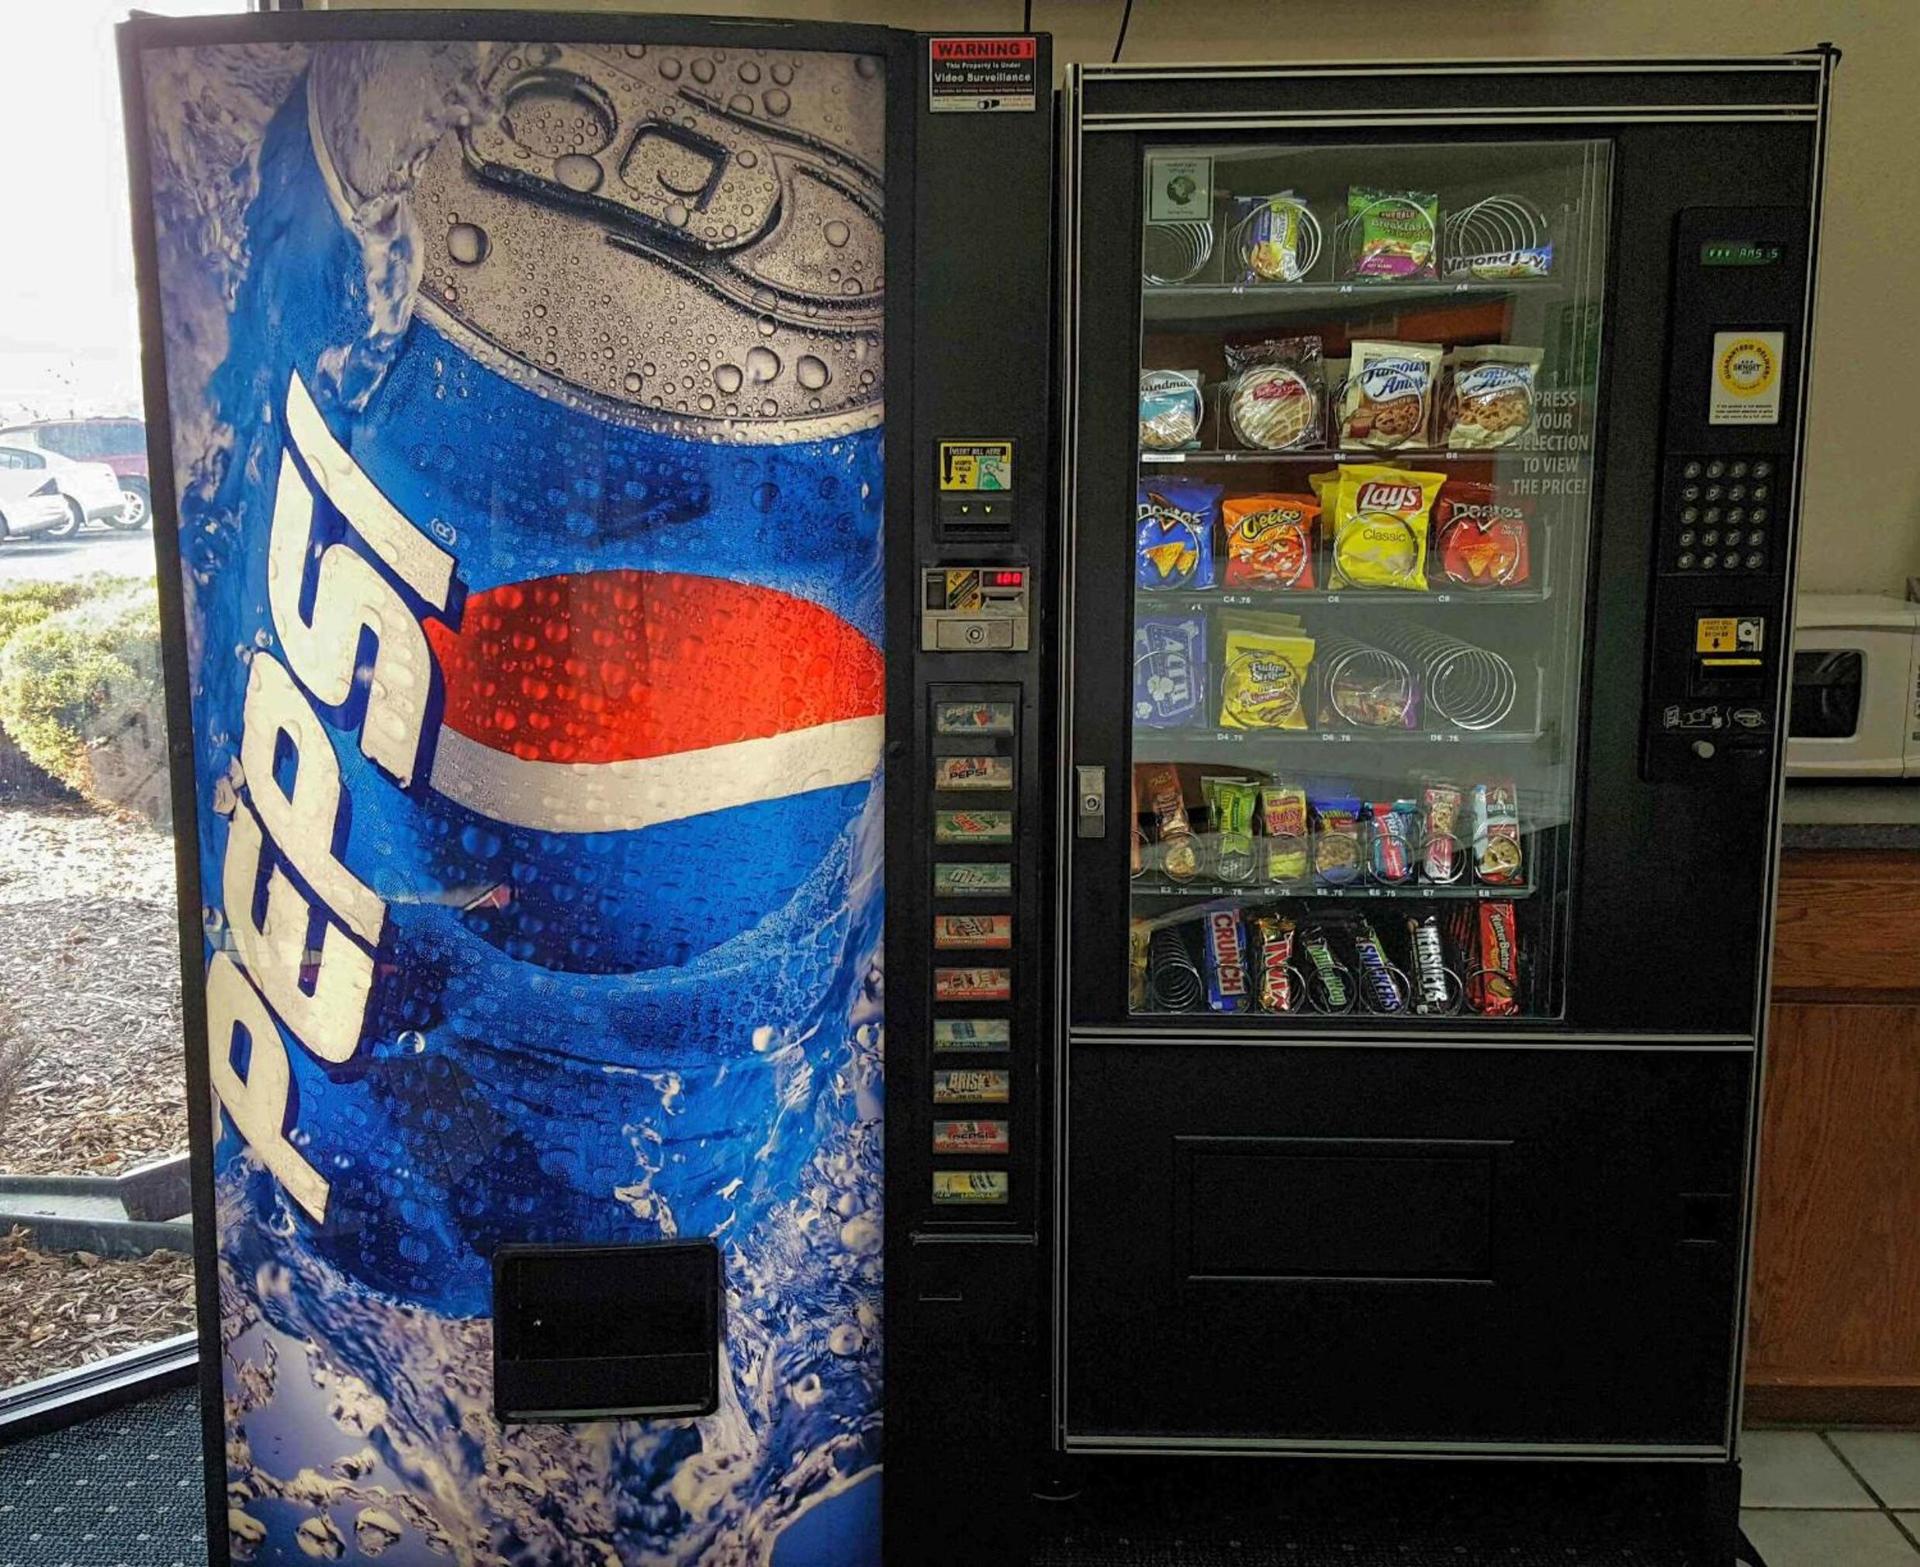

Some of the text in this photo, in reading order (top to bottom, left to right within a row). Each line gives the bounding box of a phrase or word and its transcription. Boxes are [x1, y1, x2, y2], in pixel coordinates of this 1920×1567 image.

[938, 43, 1020, 56] WARNING
[962, 62, 990, 70] Property
[935, 73, 1031, 82] Video Surveillance
[1361, 361, 1426, 384] Famous
[1535, 391, 1577, 407] PRESS
[1536, 413, 1573, 429] YOUR
[1516, 435, 1589, 450] SELECTION
[1523, 457, 1580, 473] TO VIEW
[1512, 479, 1587, 495] THE PRICE!
[1138, 504, 1202, 523] Doritos
[1453, 503, 1523, 519] Doritos
[1243, 509, 1300, 538] Cheetos
[1363, 528, 1406, 543] Classic
[946, 703, 987, 718] PEPSI
[950, 766, 987, 780] PEPSI
[210, 367, 456, 1224] PEPSI
[1213, 913, 1242, 993] CRUNCH
[1359, 944, 1400, 1011] SNICKERS
